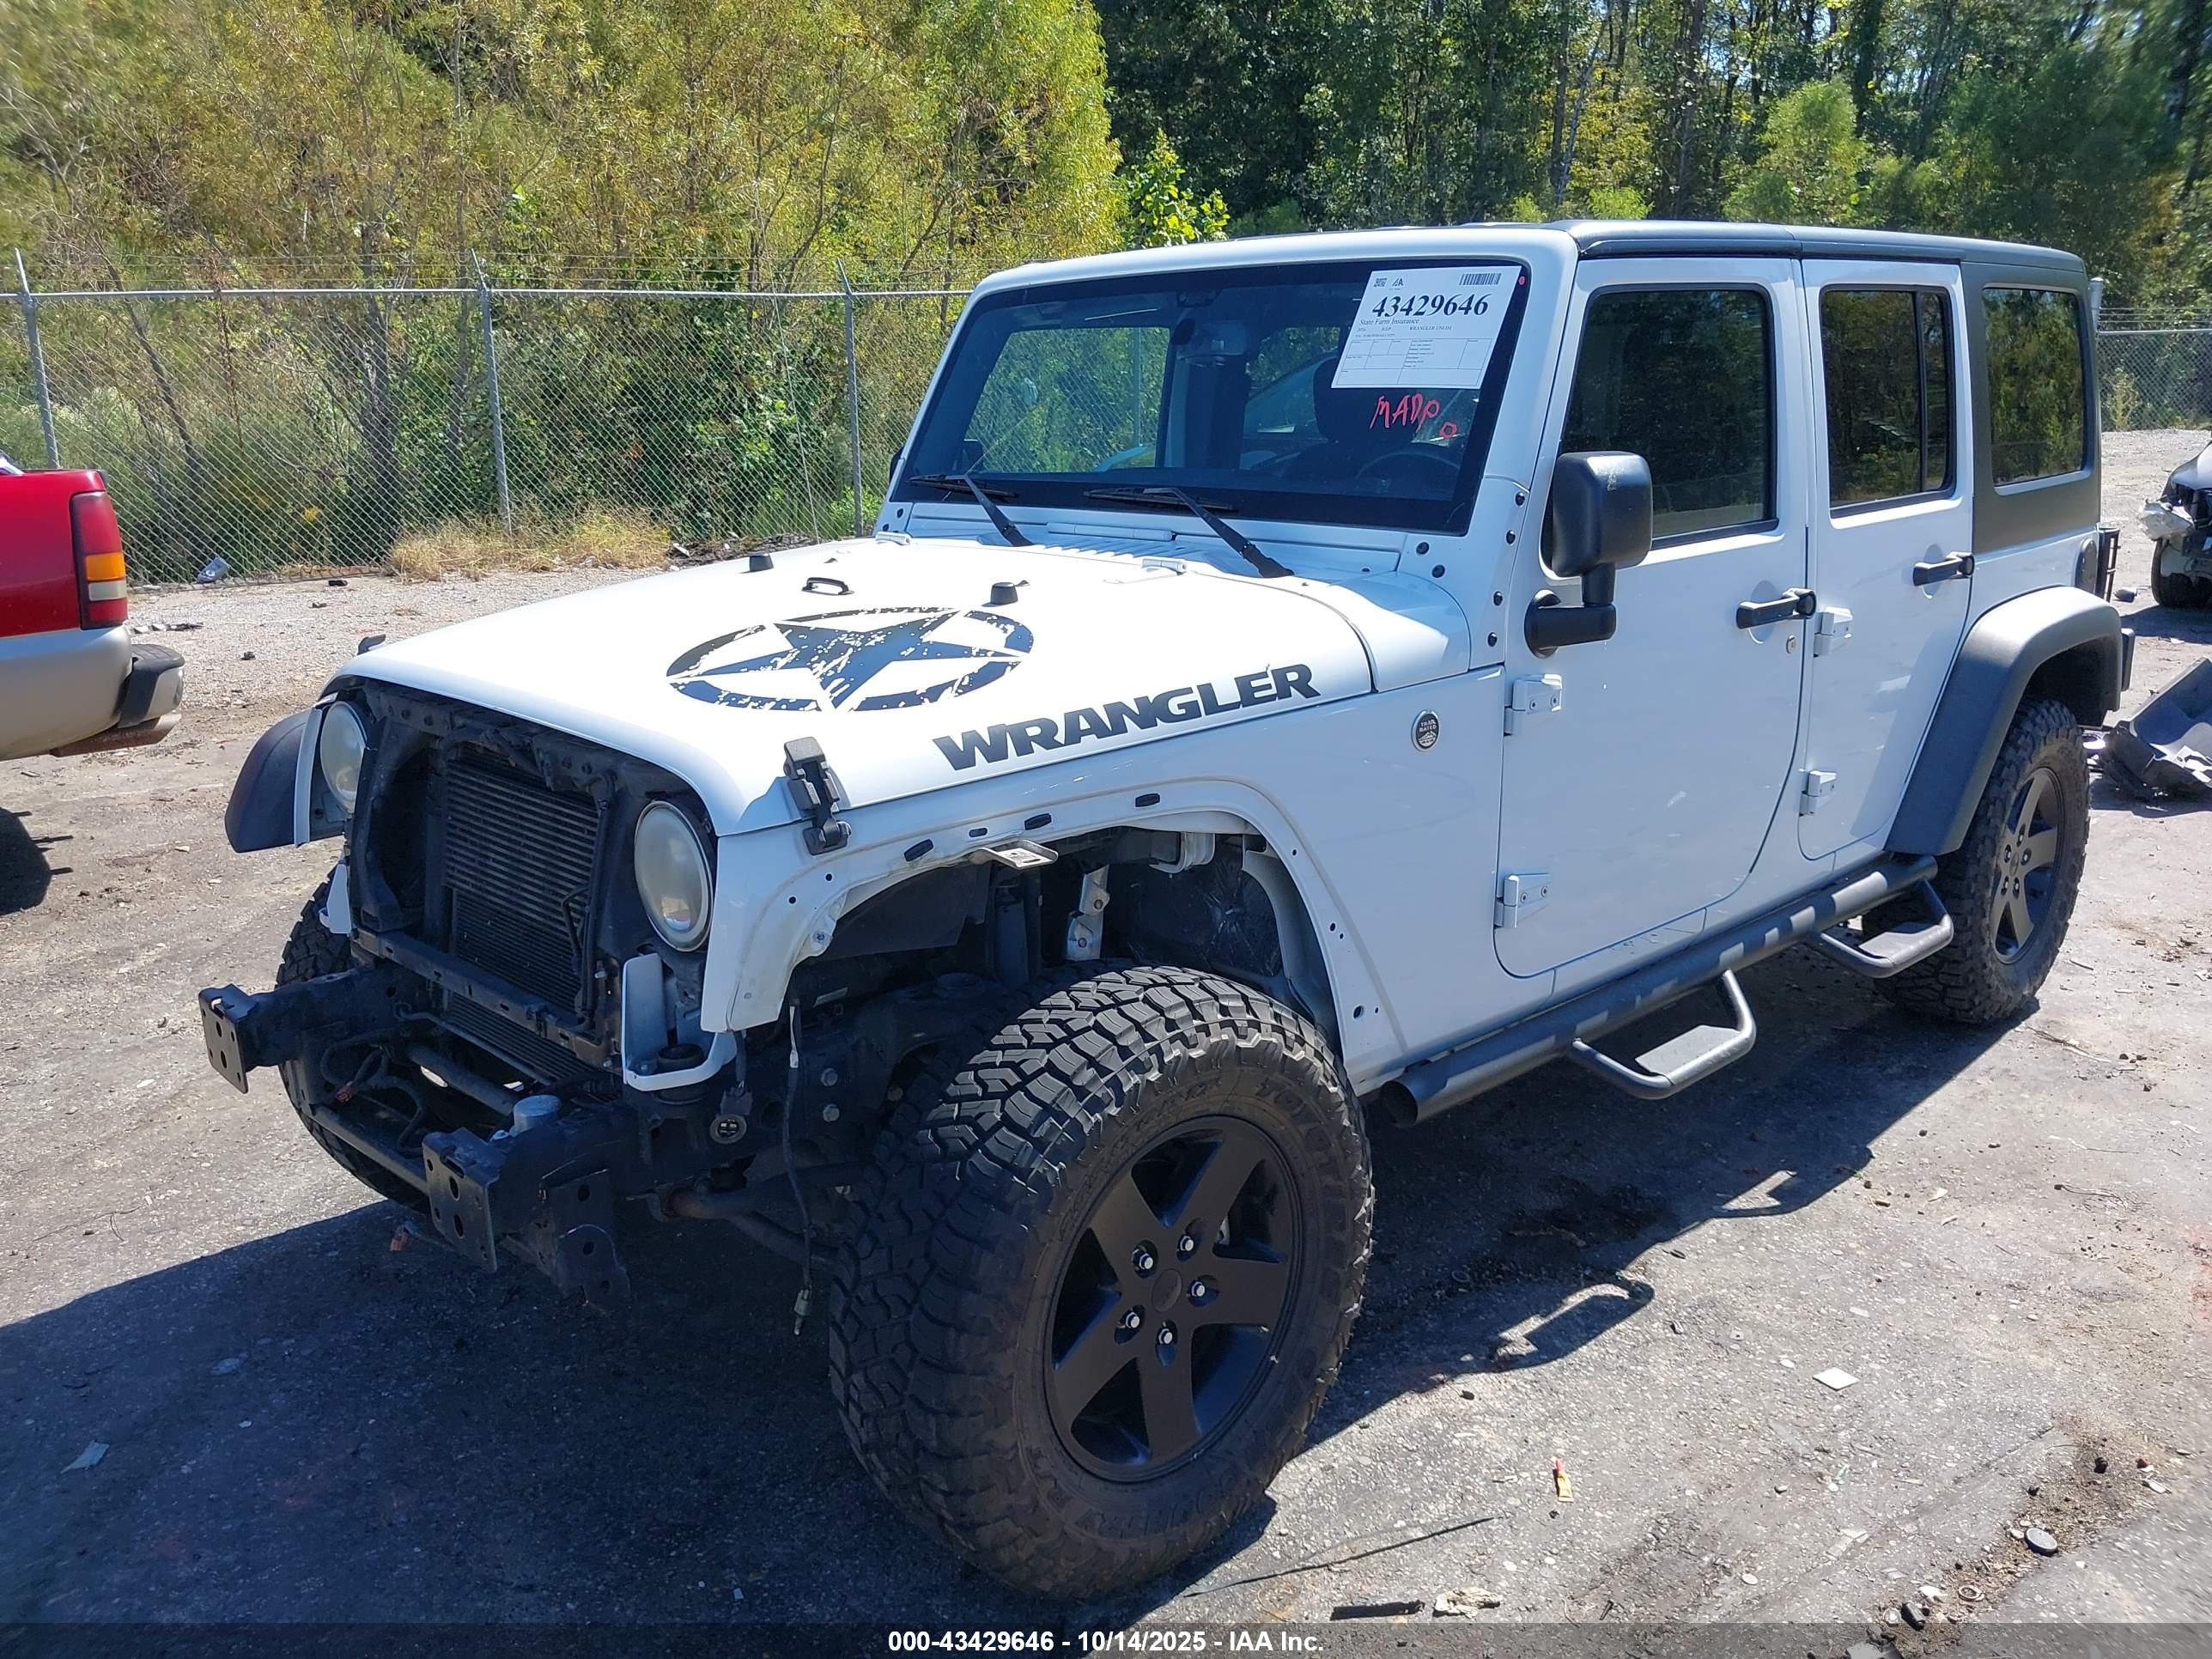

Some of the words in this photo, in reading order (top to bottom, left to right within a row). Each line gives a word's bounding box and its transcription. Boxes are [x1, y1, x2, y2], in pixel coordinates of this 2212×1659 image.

[1371, 294, 1493, 318] 43429646
[1391, 317, 1420, 325] Insurance
[933, 663, 1322, 770] WRANGLER
